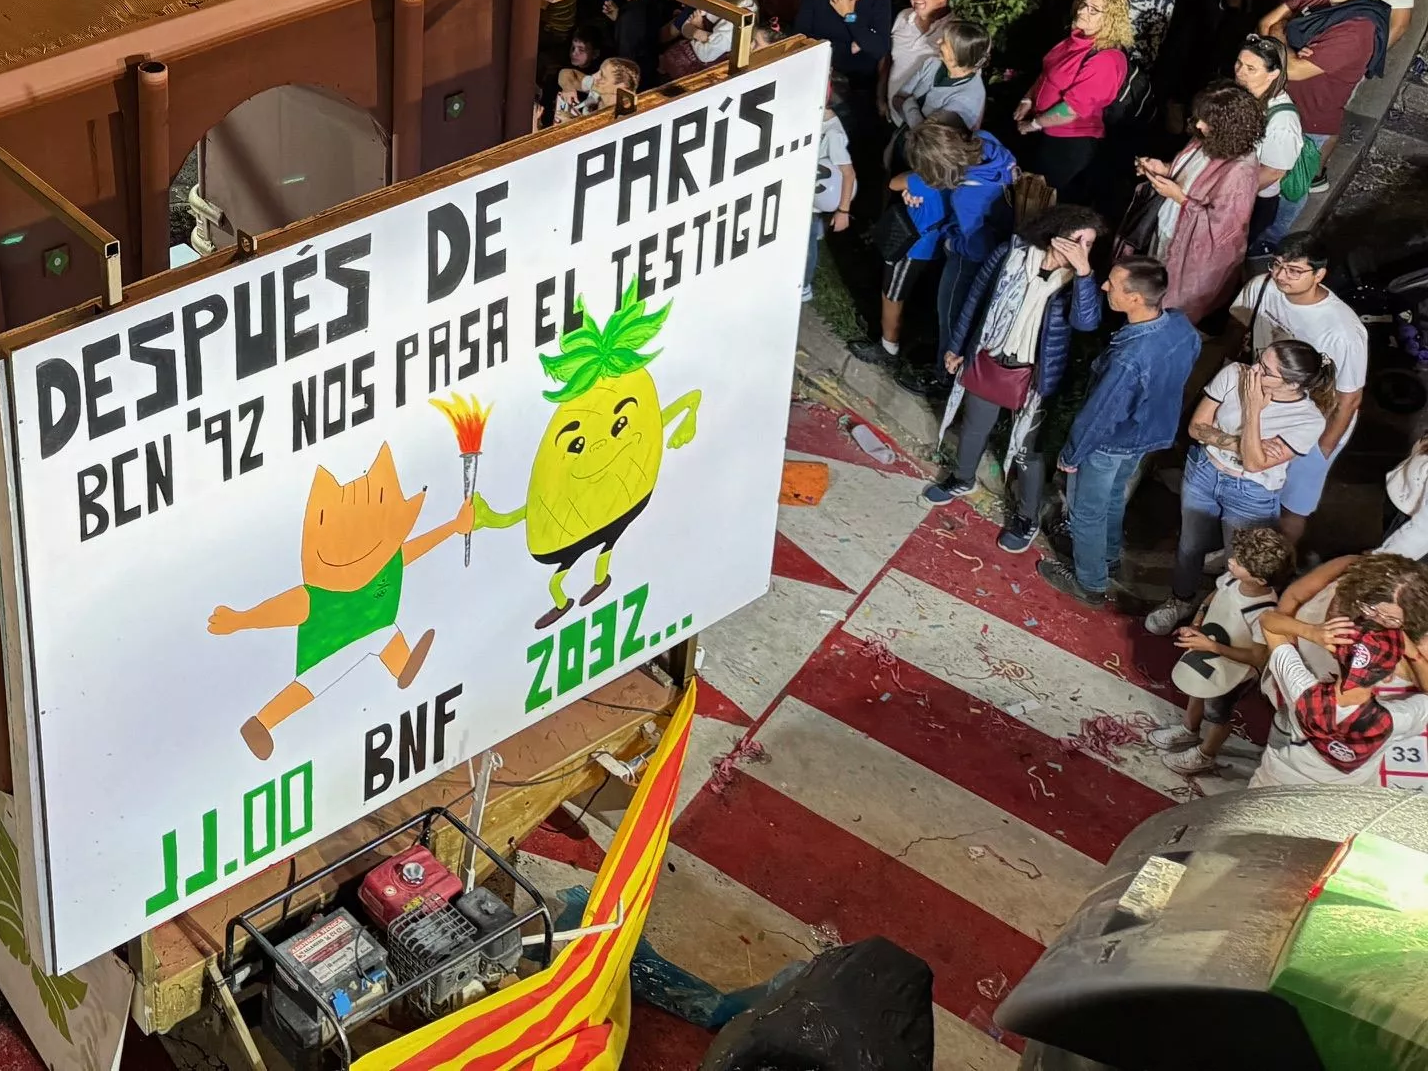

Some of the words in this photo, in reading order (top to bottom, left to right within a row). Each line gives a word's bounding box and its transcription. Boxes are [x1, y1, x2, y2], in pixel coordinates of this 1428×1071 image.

[36, 232, 372, 460] DESPUÉS
[428, 181, 509, 304] DE
[78, 434, 174, 543] BCN
[292, 351, 375, 453] NOS
[396, 296, 508, 408] PASA
[535, 268, 584, 347] EL
[364, 683, 463, 802] BNF
[1391, 746, 1422, 764] 33
